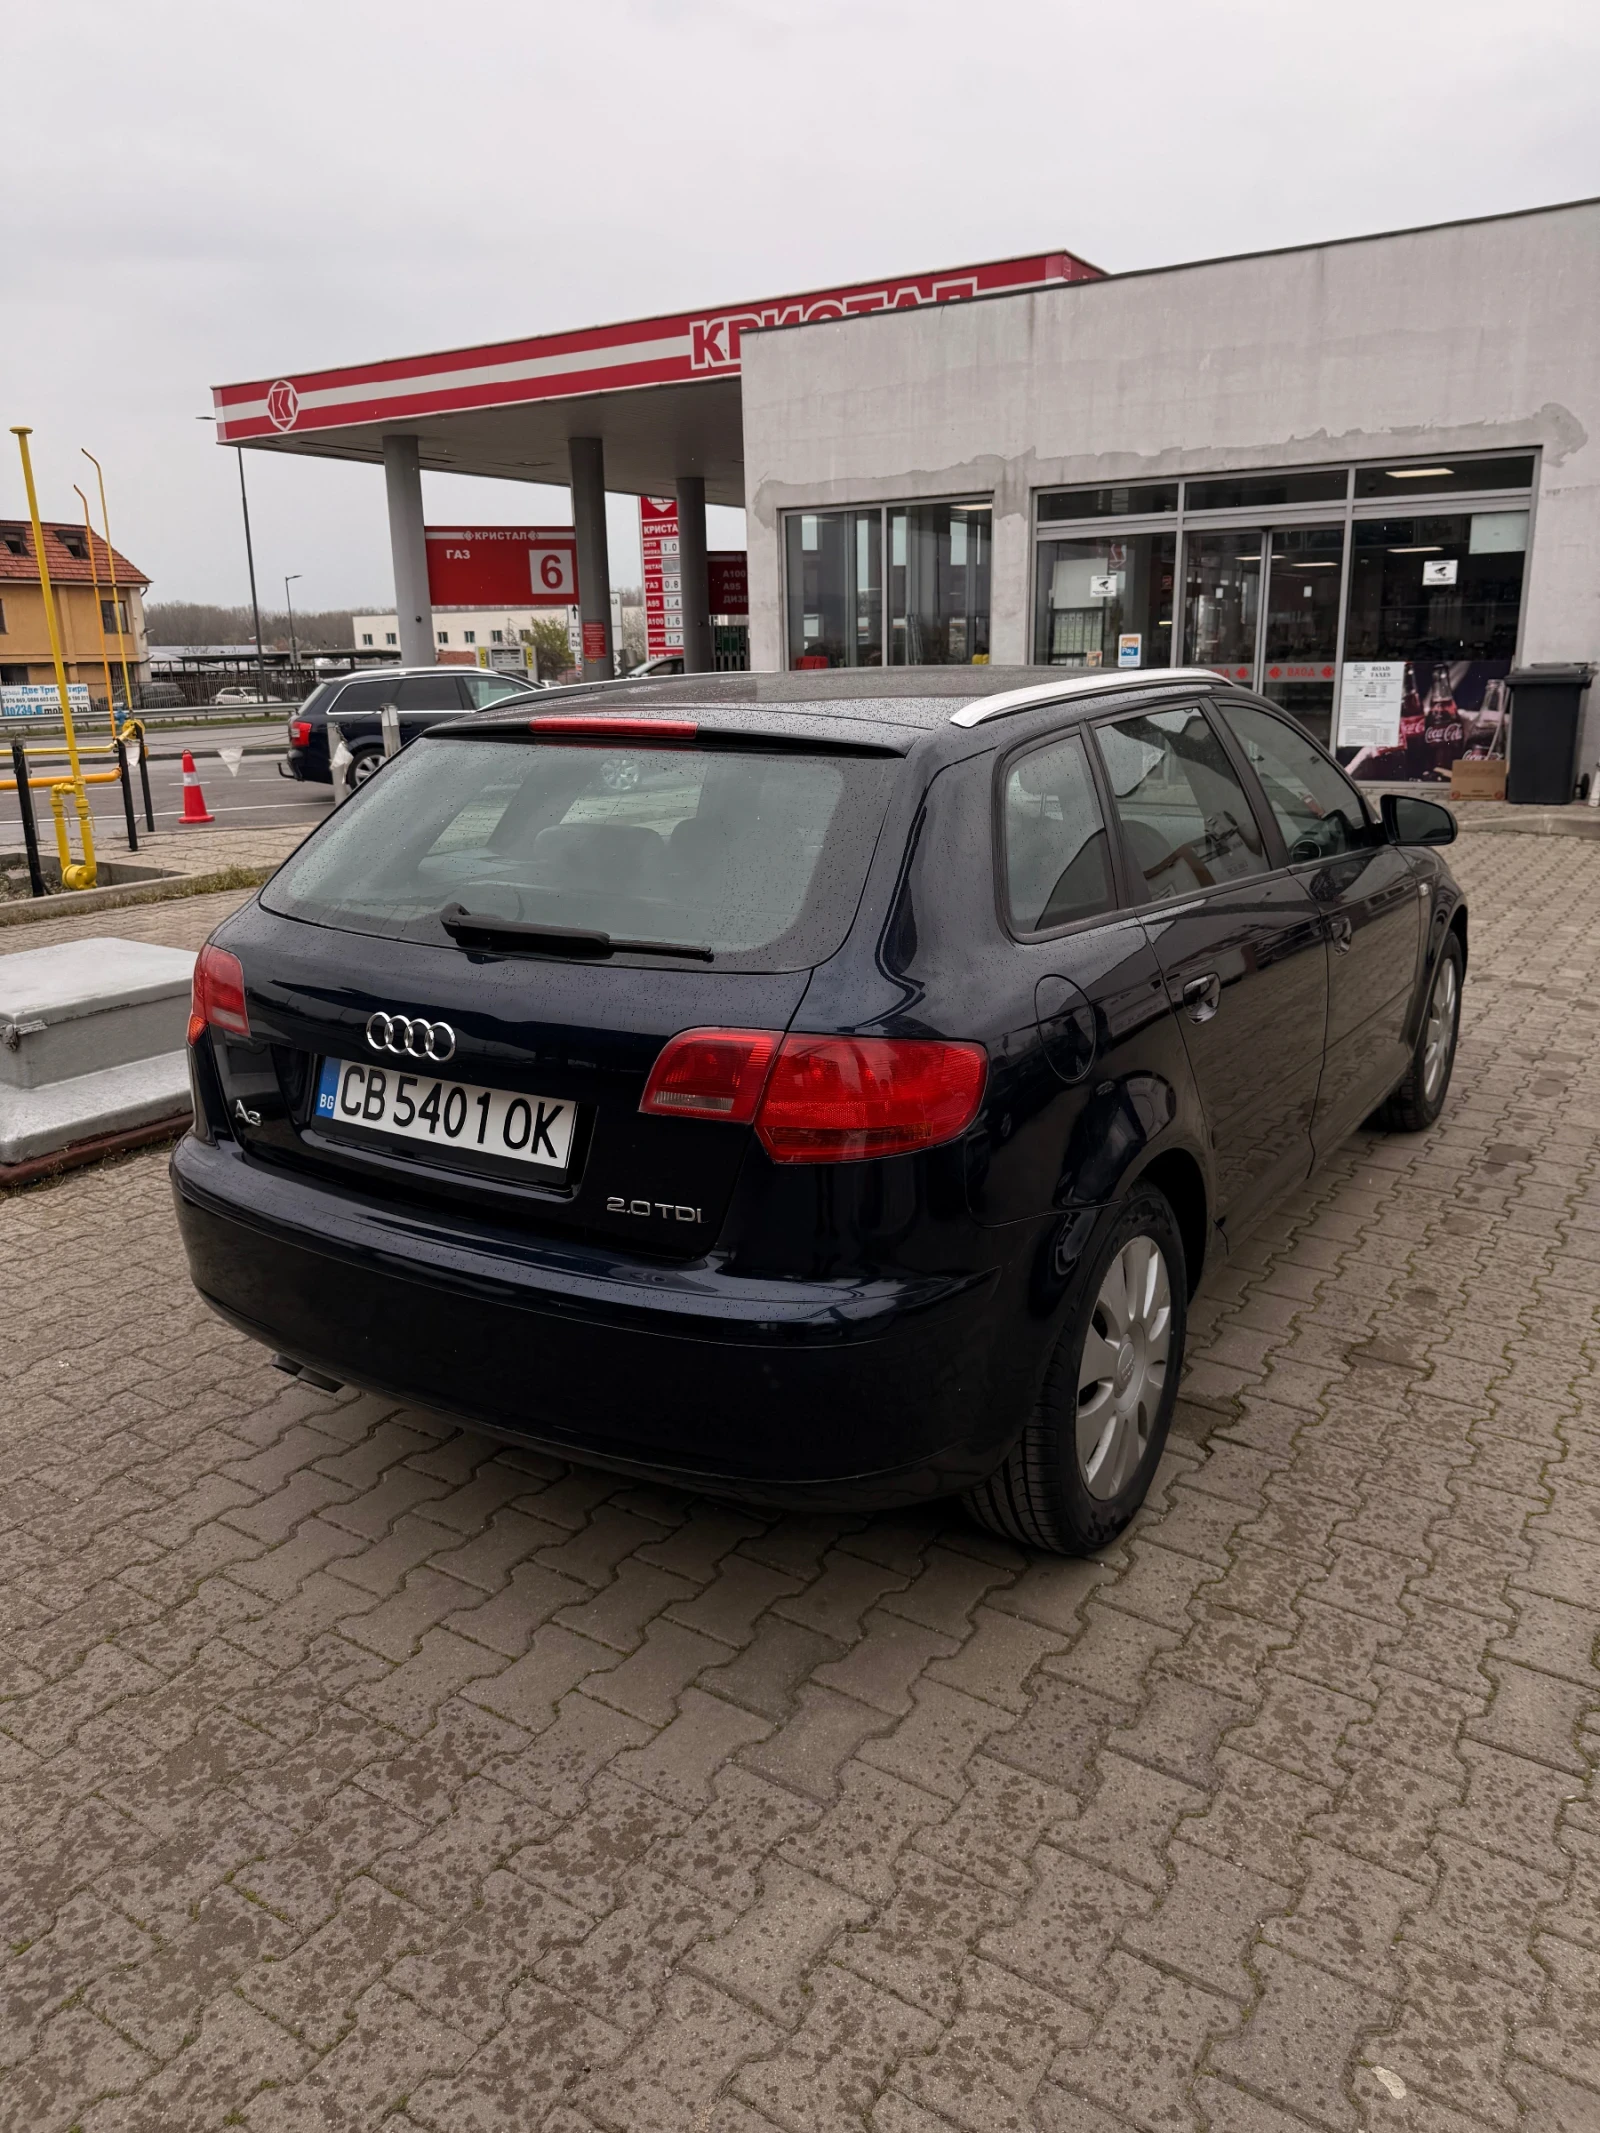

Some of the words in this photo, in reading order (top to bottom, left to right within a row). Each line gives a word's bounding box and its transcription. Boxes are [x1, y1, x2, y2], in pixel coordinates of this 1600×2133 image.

[643, 524, 679, 534] КРИСТА
[474, 532, 527, 540] КРИСТАЛ
[446, 550, 471, 559] ГАЗ
[540, 554, 563, 589] 6
[1122, 647, 1135, 656] Pay
[22, 686, 38, 695] Две
[40, 686, 56, 695] Три
[44, 705, 88, 714] mobe.bg
[319, 1093, 335, 1110] BG
[235, 1099, 262, 1126] A3
[606, 1196, 651, 1217] 2.0
[654, 1203, 702, 1223] TDI
